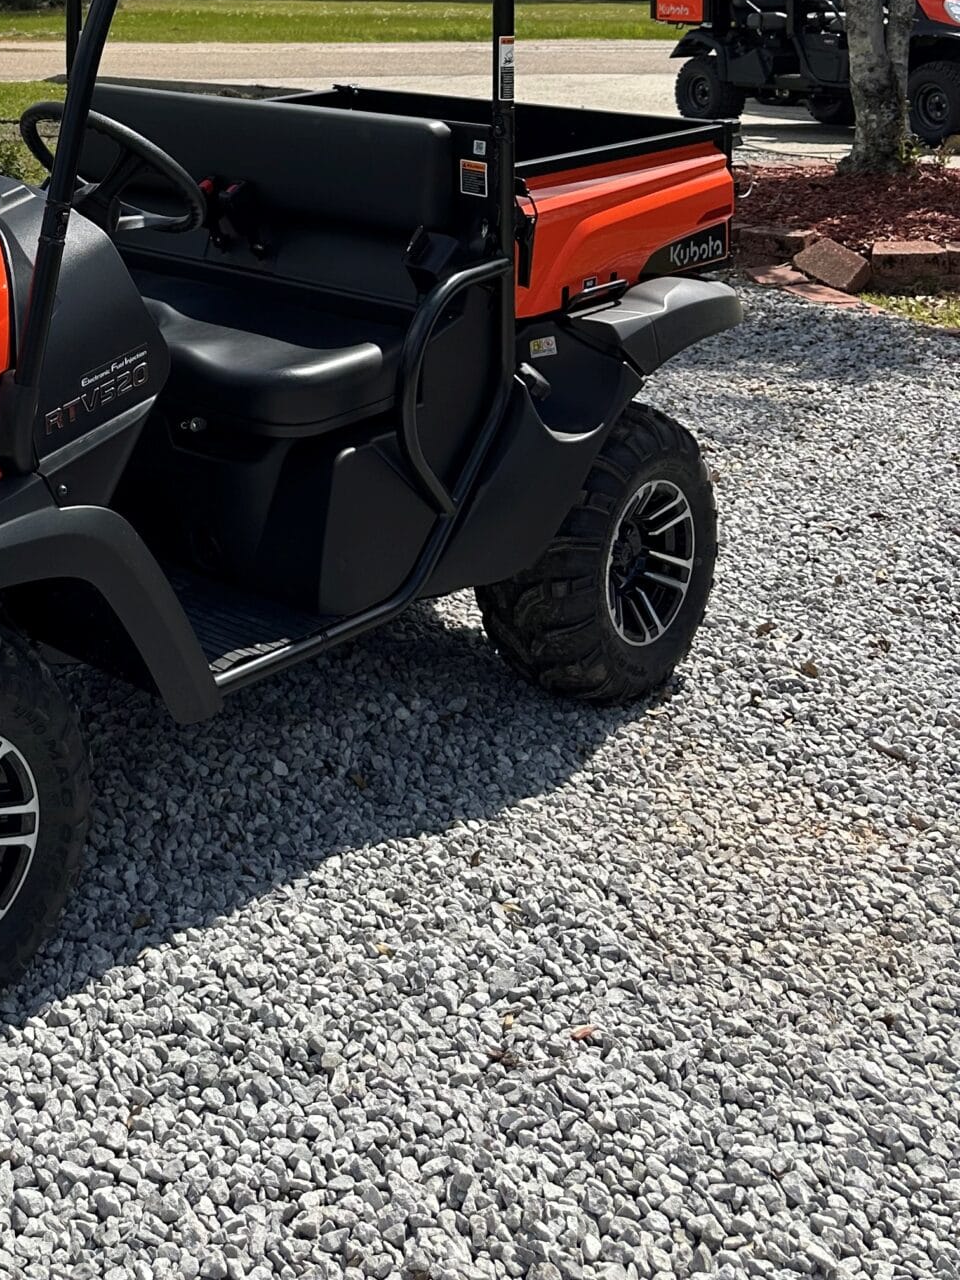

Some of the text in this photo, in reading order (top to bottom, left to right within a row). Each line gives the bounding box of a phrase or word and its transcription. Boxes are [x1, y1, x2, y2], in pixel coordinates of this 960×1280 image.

[659, 4, 689, 16] Kubota
[670, 235, 723, 267] Kubota
[44, 362, 148, 436] RTV520
